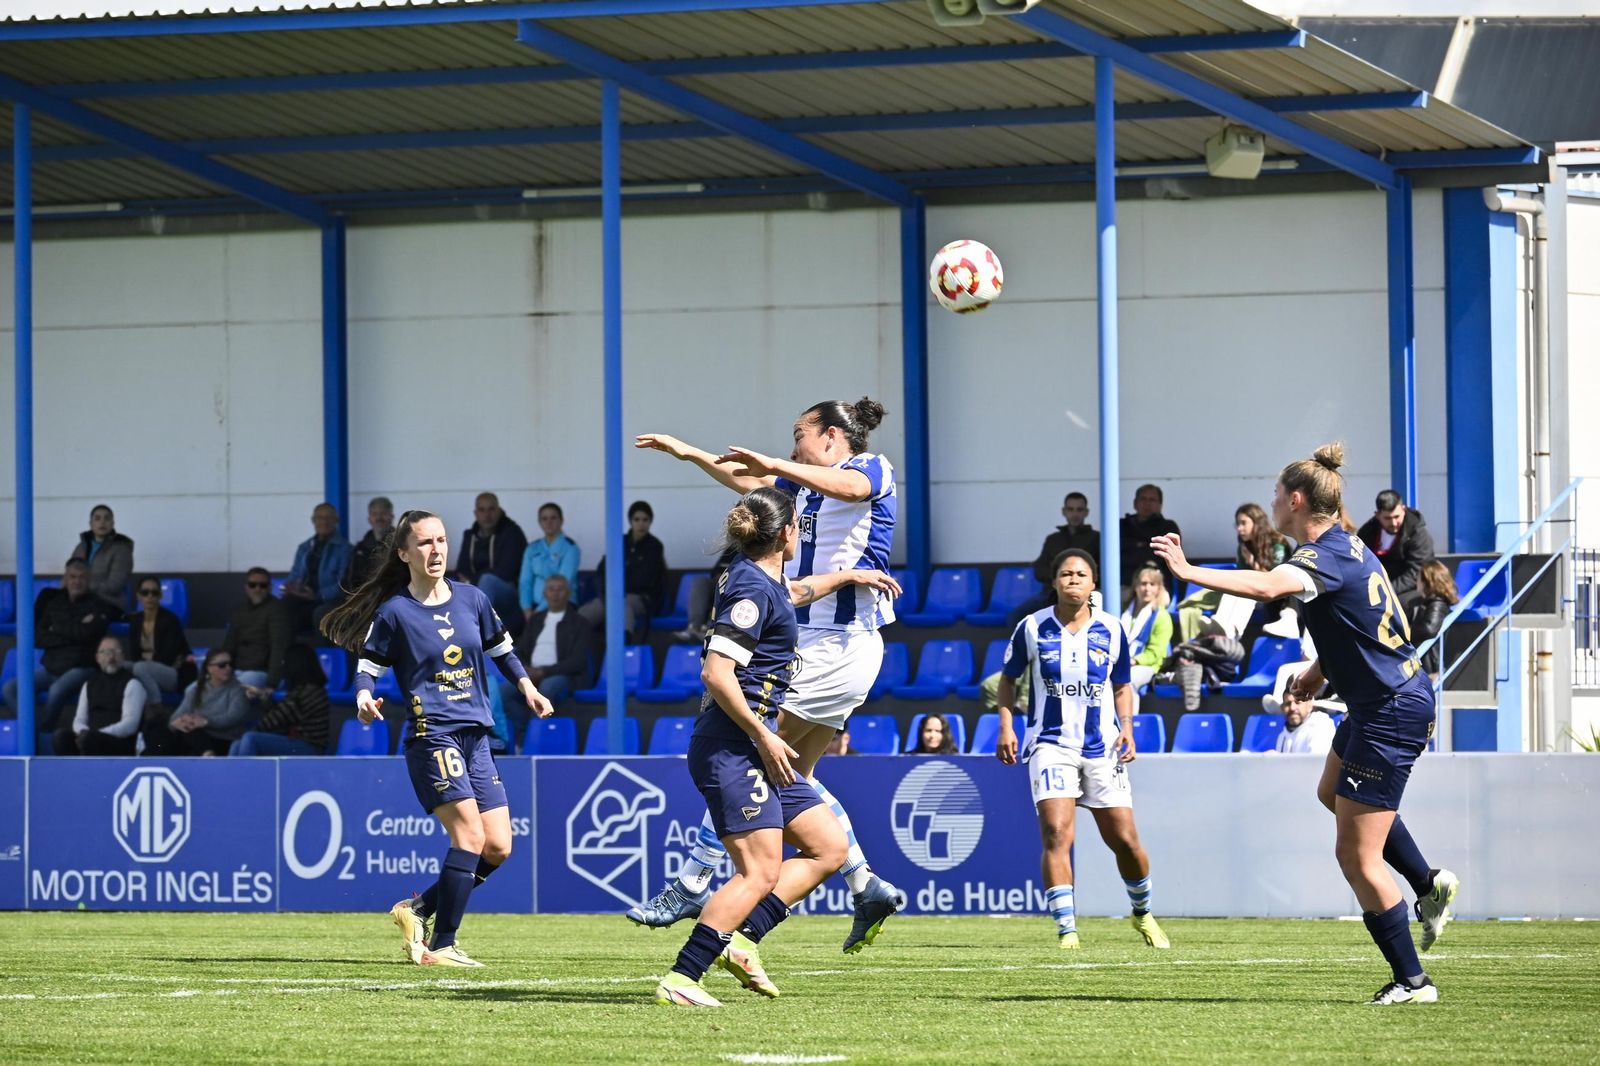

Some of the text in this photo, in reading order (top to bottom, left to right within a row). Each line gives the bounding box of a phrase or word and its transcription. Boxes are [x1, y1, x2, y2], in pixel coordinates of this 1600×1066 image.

[433, 748, 464, 780] 16
[1041, 767, 1065, 792] 15
[747, 769, 769, 803] 3
[120, 776, 183, 854] MG
[366, 809, 435, 836] Centro
[366, 850, 440, 875] Huelva
[32, 864, 273, 903] MOTOR INGLÉS
[917, 879, 954, 911] de
[964, 879, 1049, 912] Huelv
